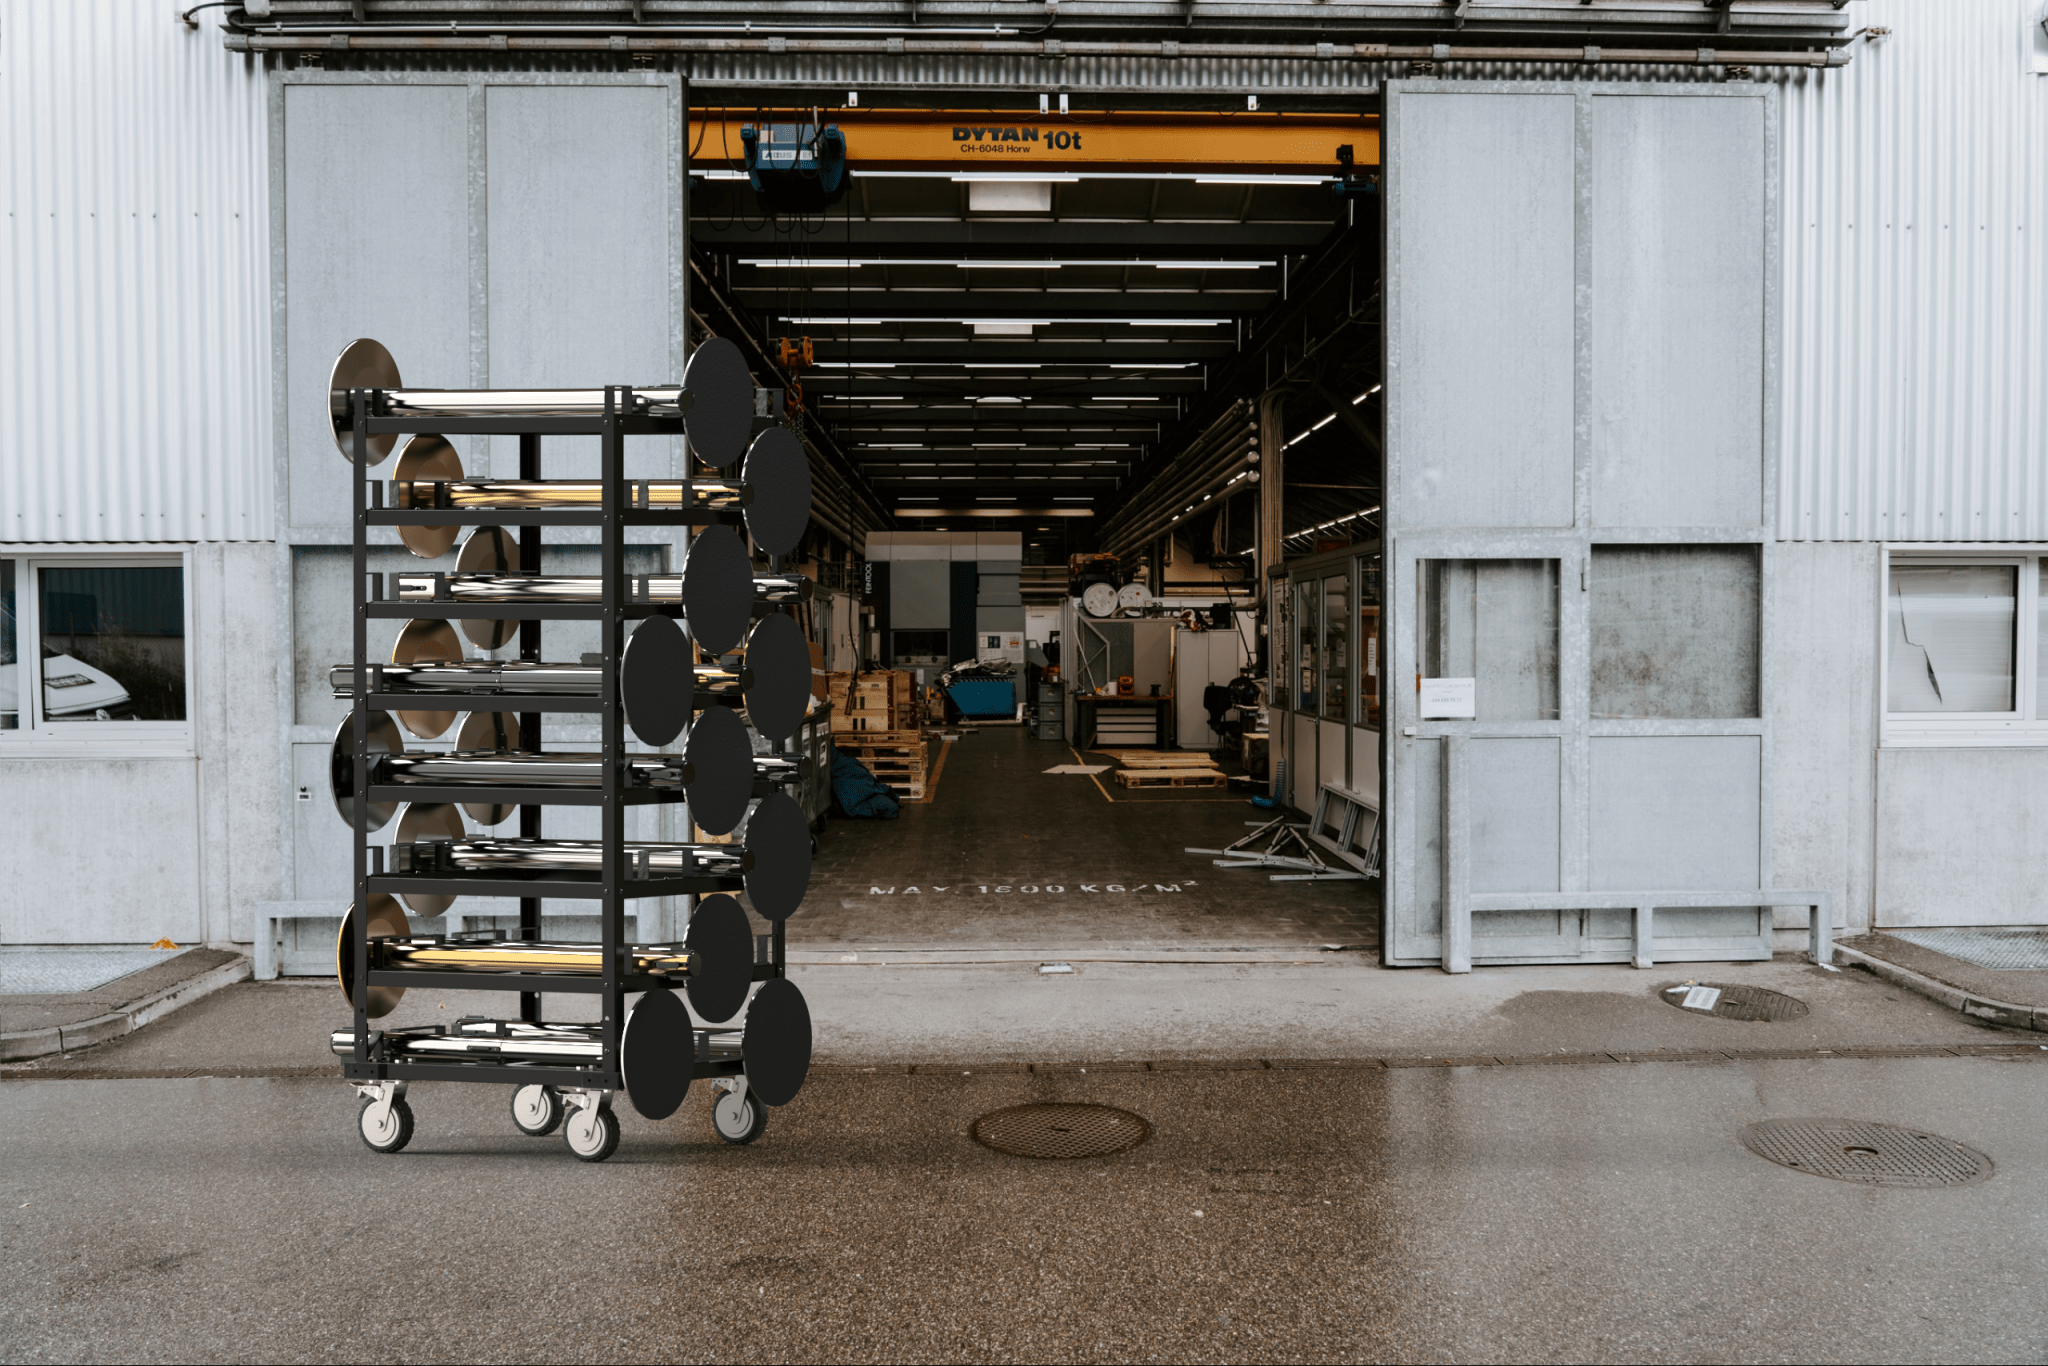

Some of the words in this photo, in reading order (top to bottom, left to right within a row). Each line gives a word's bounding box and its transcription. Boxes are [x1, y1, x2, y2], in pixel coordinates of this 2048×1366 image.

[952, 127, 1039, 142] DYTAN
[1043, 130, 1082, 150] 10t
[960, 144, 1004, 153] CH-6048
[1006, 144, 1031, 153] Horw
